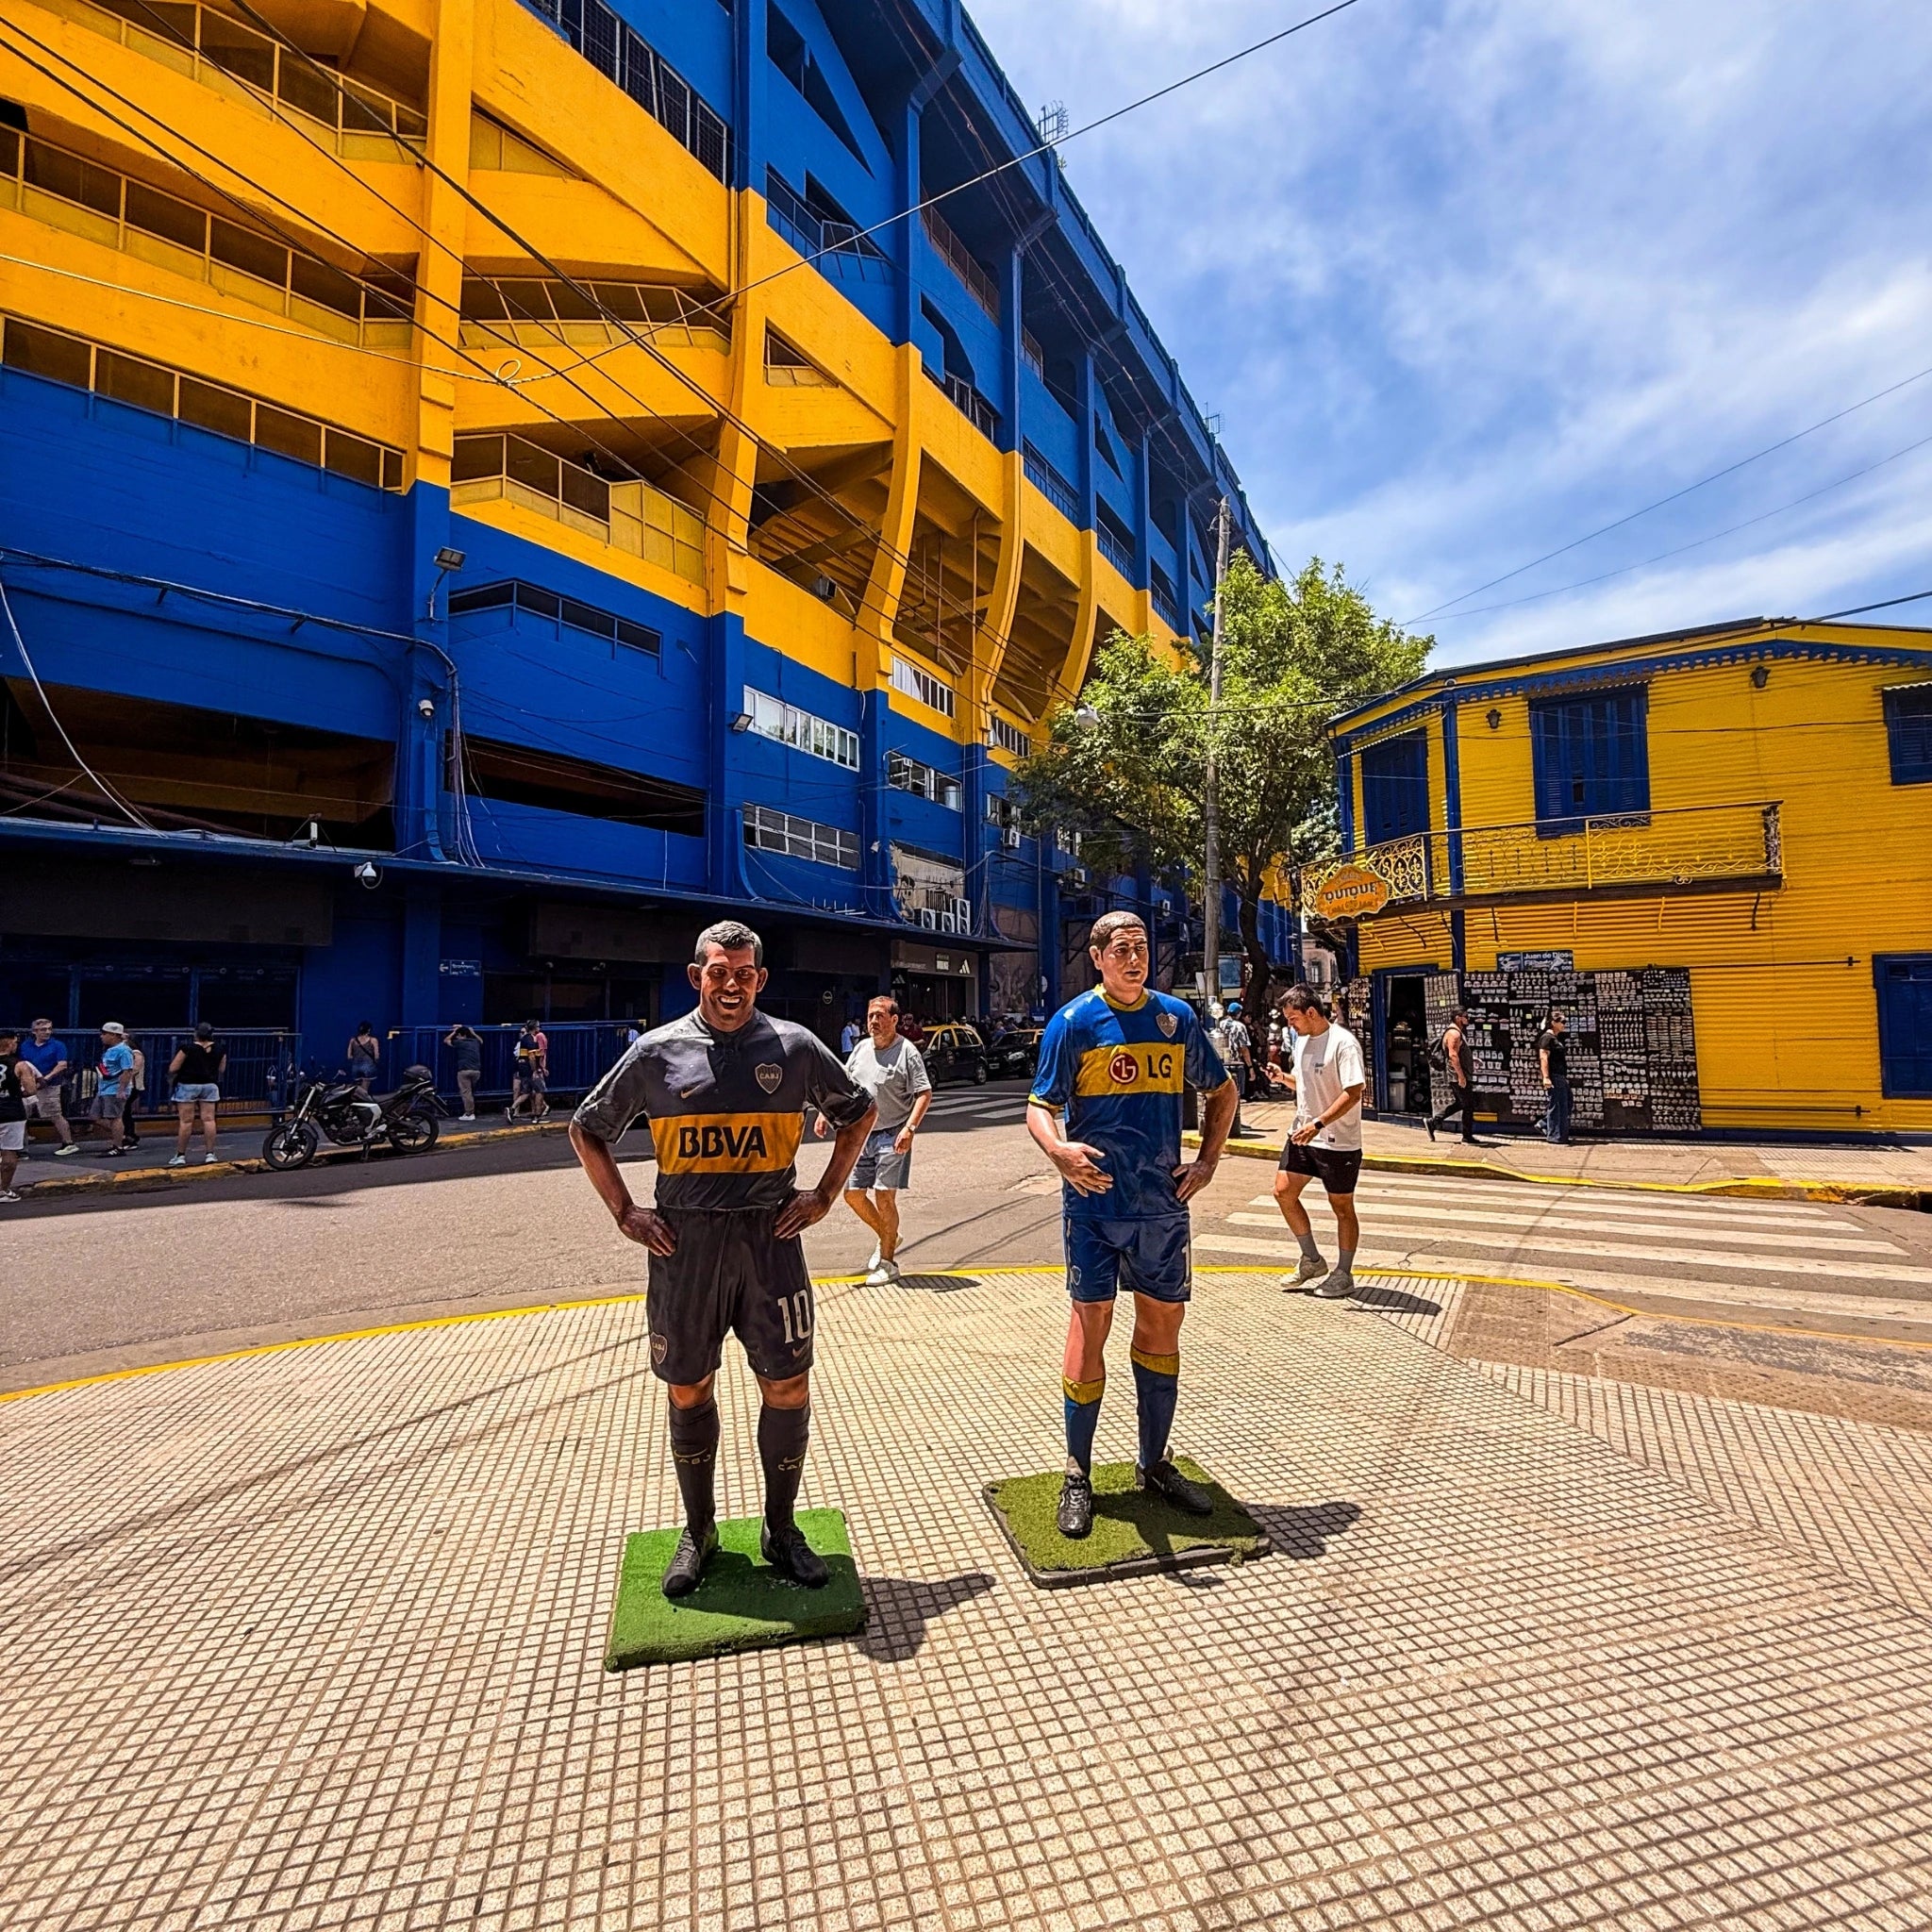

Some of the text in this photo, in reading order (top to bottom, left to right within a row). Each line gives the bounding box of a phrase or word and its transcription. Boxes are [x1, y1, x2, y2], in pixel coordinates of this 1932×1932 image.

[1324, 882, 1377, 904] QUIQUE
[1147, 1053, 1173, 1079] LG
[678, 1125, 767, 1158] BBVA
[777, 1289, 812, 1344] 10
